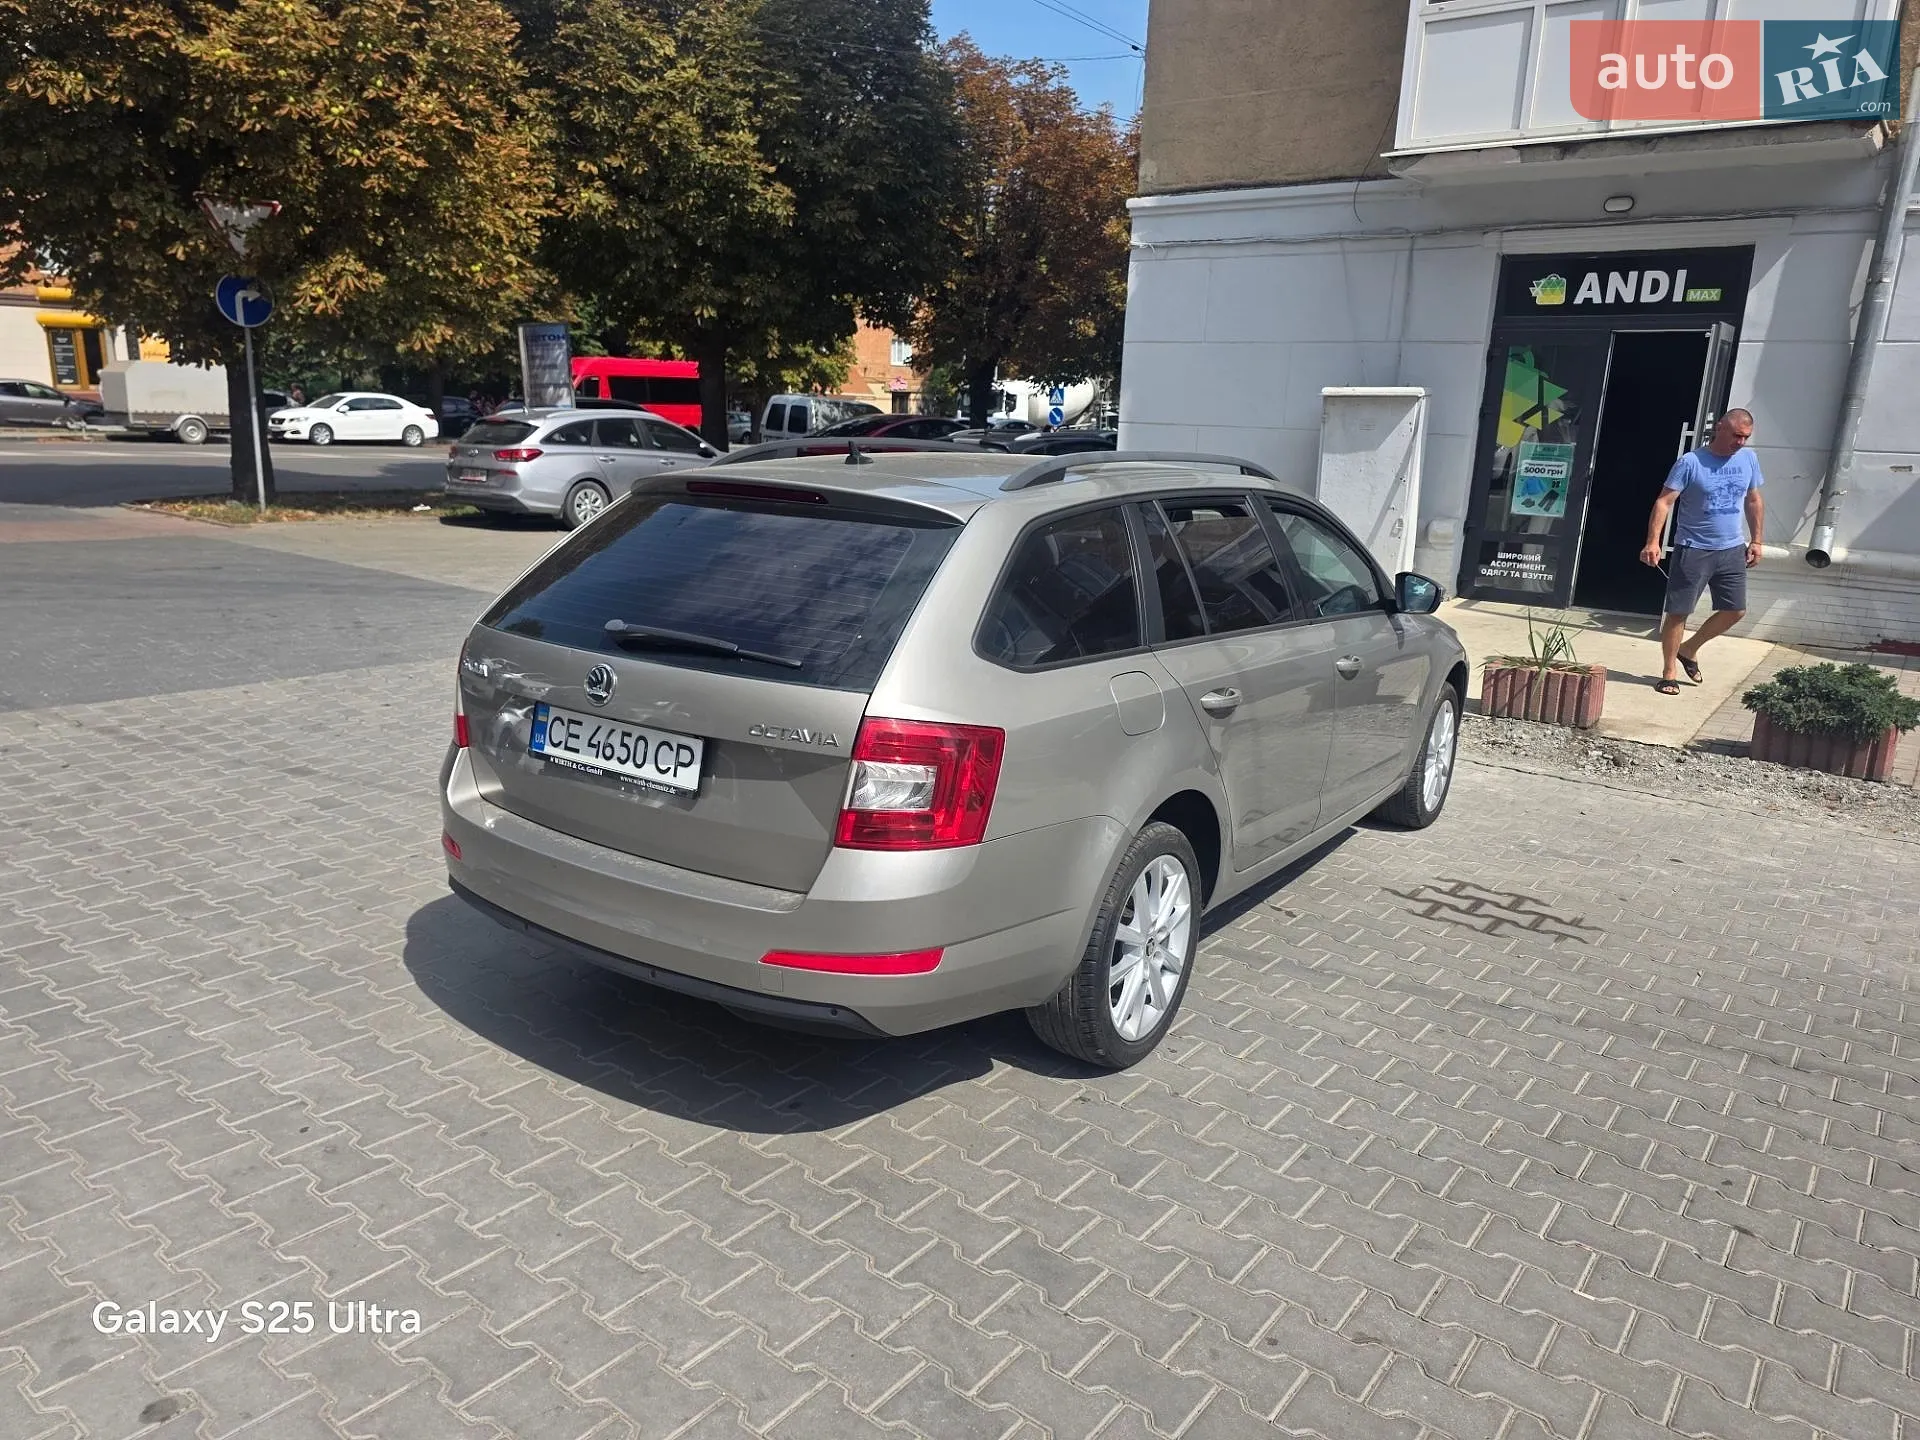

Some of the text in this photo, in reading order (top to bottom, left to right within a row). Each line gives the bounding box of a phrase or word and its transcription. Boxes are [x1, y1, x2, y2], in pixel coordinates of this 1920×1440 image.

[1573, 269, 1720, 305] ANDI MAX
[1523, 466, 1563, 477] 5000 грн
[1497, 552, 1542, 562] ШИРОКИЙ
[1490, 560, 1546, 572] АСОРТИМЕНТ
[1480, 568, 1553, 581] ОДЯГУ ТА ВЗУТТЯ
[534, 733, 545, 745] UA
[748, 723, 840, 748] OCTAVIA
[548, 715, 695, 778] CE 4650 CP
[586, 766, 603, 776] GmbH
